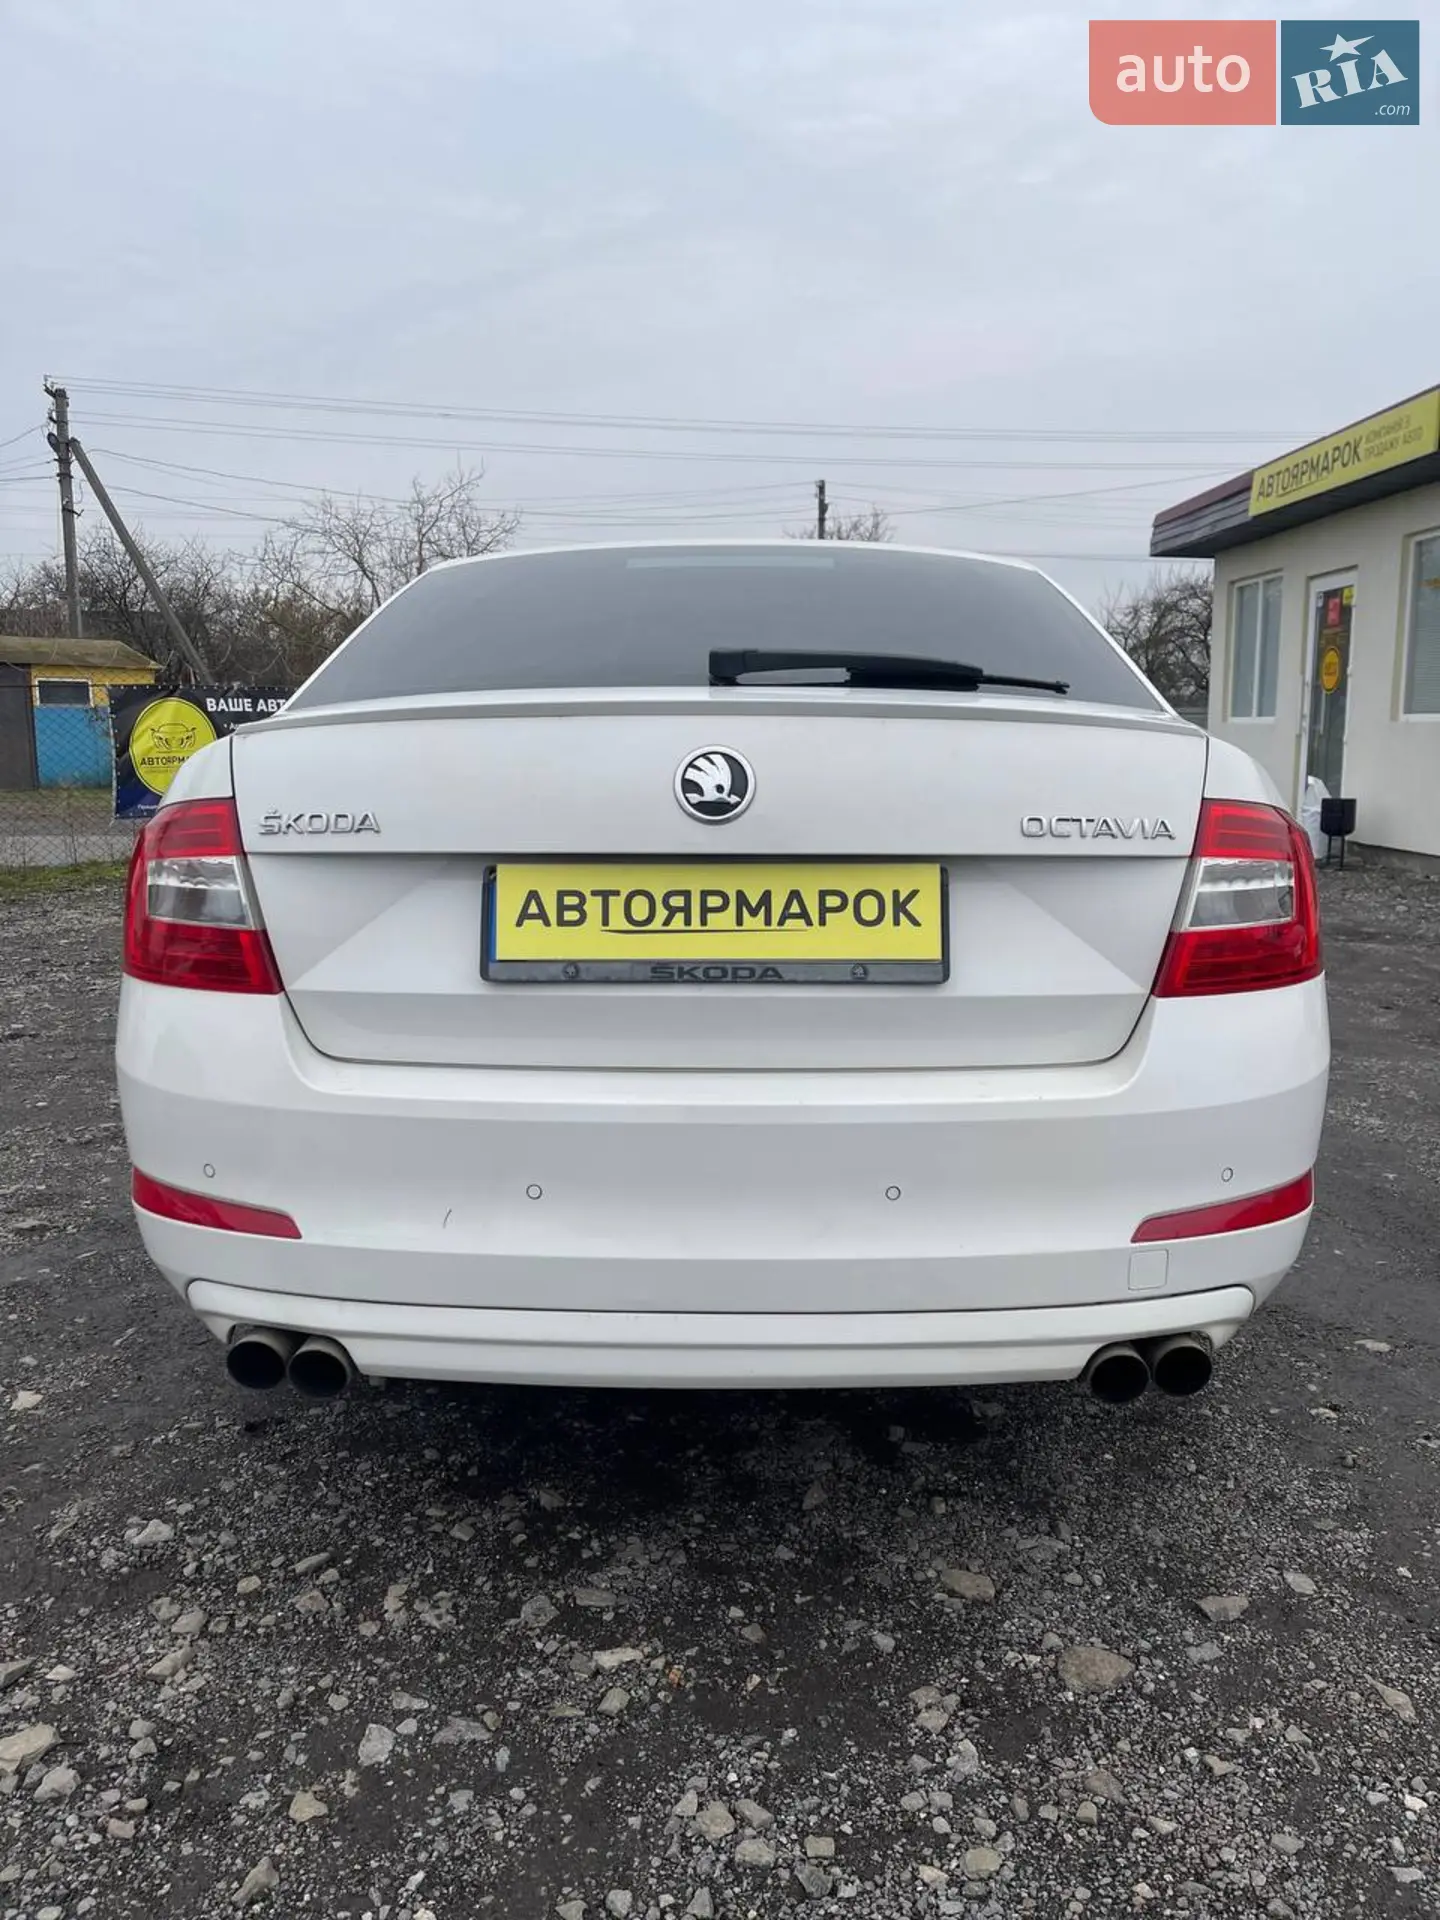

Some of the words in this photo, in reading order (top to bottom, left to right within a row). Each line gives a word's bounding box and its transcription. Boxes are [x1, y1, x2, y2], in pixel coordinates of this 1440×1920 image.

[1256, 435, 1363, 501] АВТОЯРМАРОК
[206, 697, 253, 712] ВАШЕ
[259, 808, 381, 835] ŠKODA
[1021, 814, 1176, 840] OCTAVIA
[515, 889, 922, 928] АВТОЯРМАРОК
